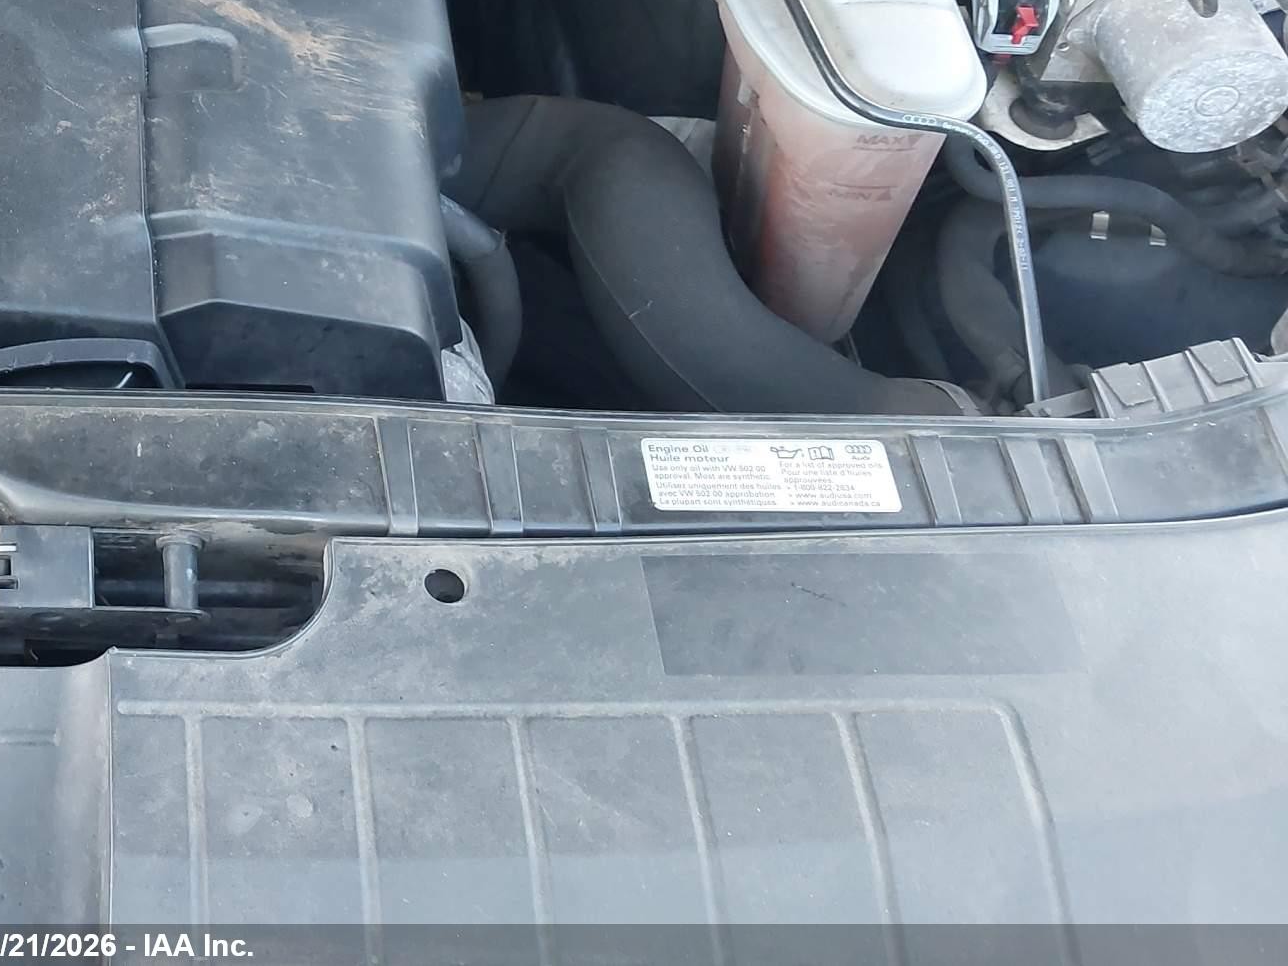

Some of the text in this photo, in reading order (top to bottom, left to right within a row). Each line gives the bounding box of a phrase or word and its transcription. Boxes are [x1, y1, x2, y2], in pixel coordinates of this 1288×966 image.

[857, 135, 903, 145] MAX
[648, 444, 689, 454] Engine
[692, 444, 709, 453] Oil
[650, 454, 730, 463] Huile moteur
[652, 464, 668, 472] Use
[670, 464, 688, 473] only
[690, 464, 700, 472] oil
[702, 464, 721, 472] with
[739, 465, 753, 473] 502
[755, 465, 766, 473] 00
[802, 461, 815, 469] list
[817, 461, 825, 469] of
[827, 461, 866, 470] approved
[694, 472, 714, 480] Most
[781, 468, 800, 476] Pour
[820, 468, 838, 476] liste
[688, 481, 737, 490] uniquement
[739, 481, 754, 490] des
[756, 481, 782, 490] huiles
[658, 490, 677, 498] avec
[679, 490, 694, 498] VW
[696, 490, 710, 498] 502
[712, 490, 723, 498] 00
[671, 498, 701, 507] plupart
[703, 498, 721, 506] sont
